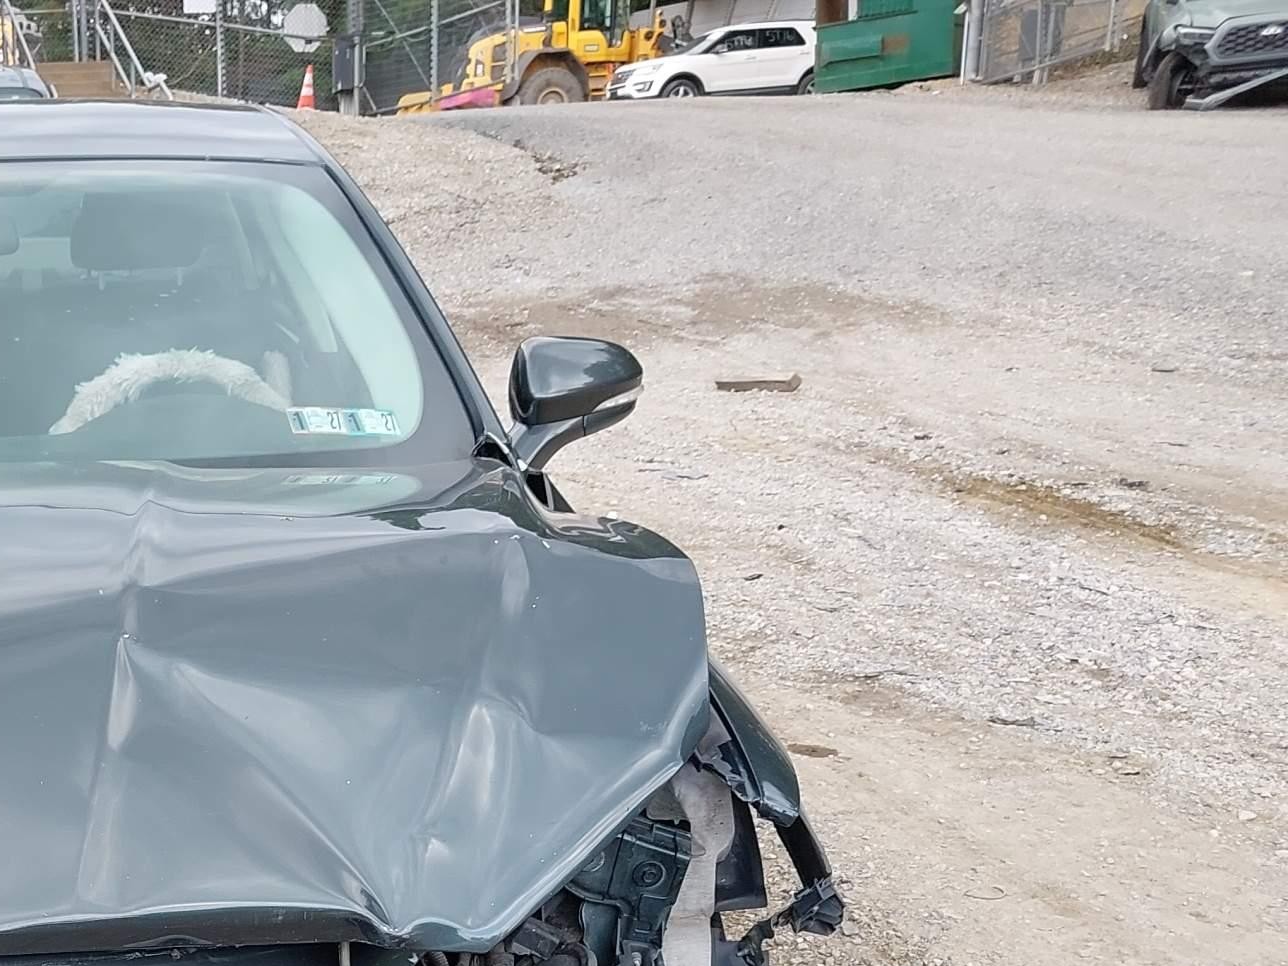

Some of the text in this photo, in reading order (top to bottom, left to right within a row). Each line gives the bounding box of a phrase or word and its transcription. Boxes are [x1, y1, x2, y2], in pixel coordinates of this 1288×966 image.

[293, 411, 305, 431] 1
[326, 411, 342, 431] 27
[348, 413, 361, 432] 1
[381, 413, 397, 432] 27
